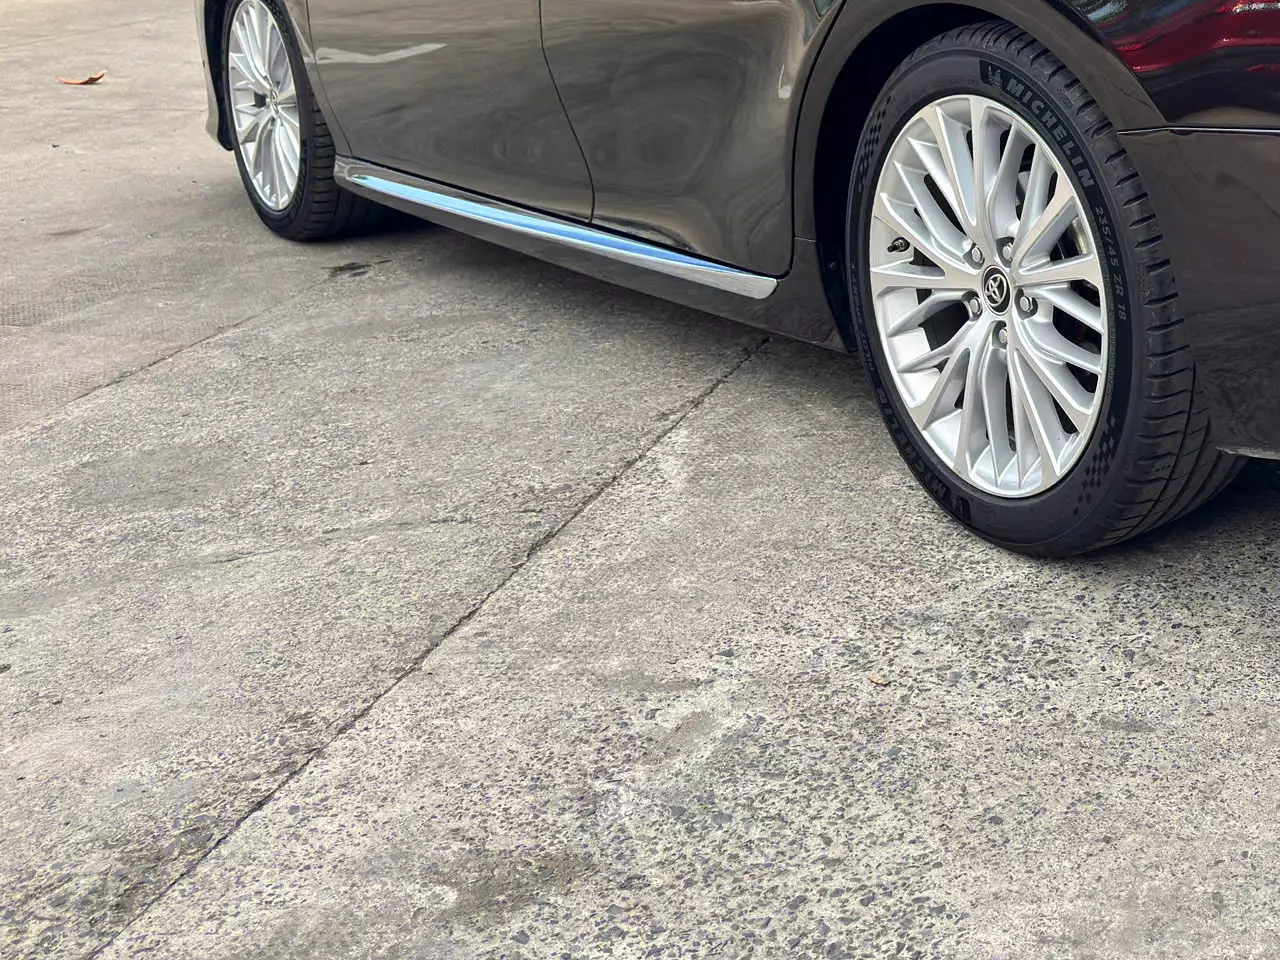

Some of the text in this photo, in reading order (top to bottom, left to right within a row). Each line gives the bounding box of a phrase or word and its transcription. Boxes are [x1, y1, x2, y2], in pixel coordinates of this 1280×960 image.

[1006, 78, 1095, 188] MICHELIN
[1095, 204, 1127, 321] 235/45 ZR 18
